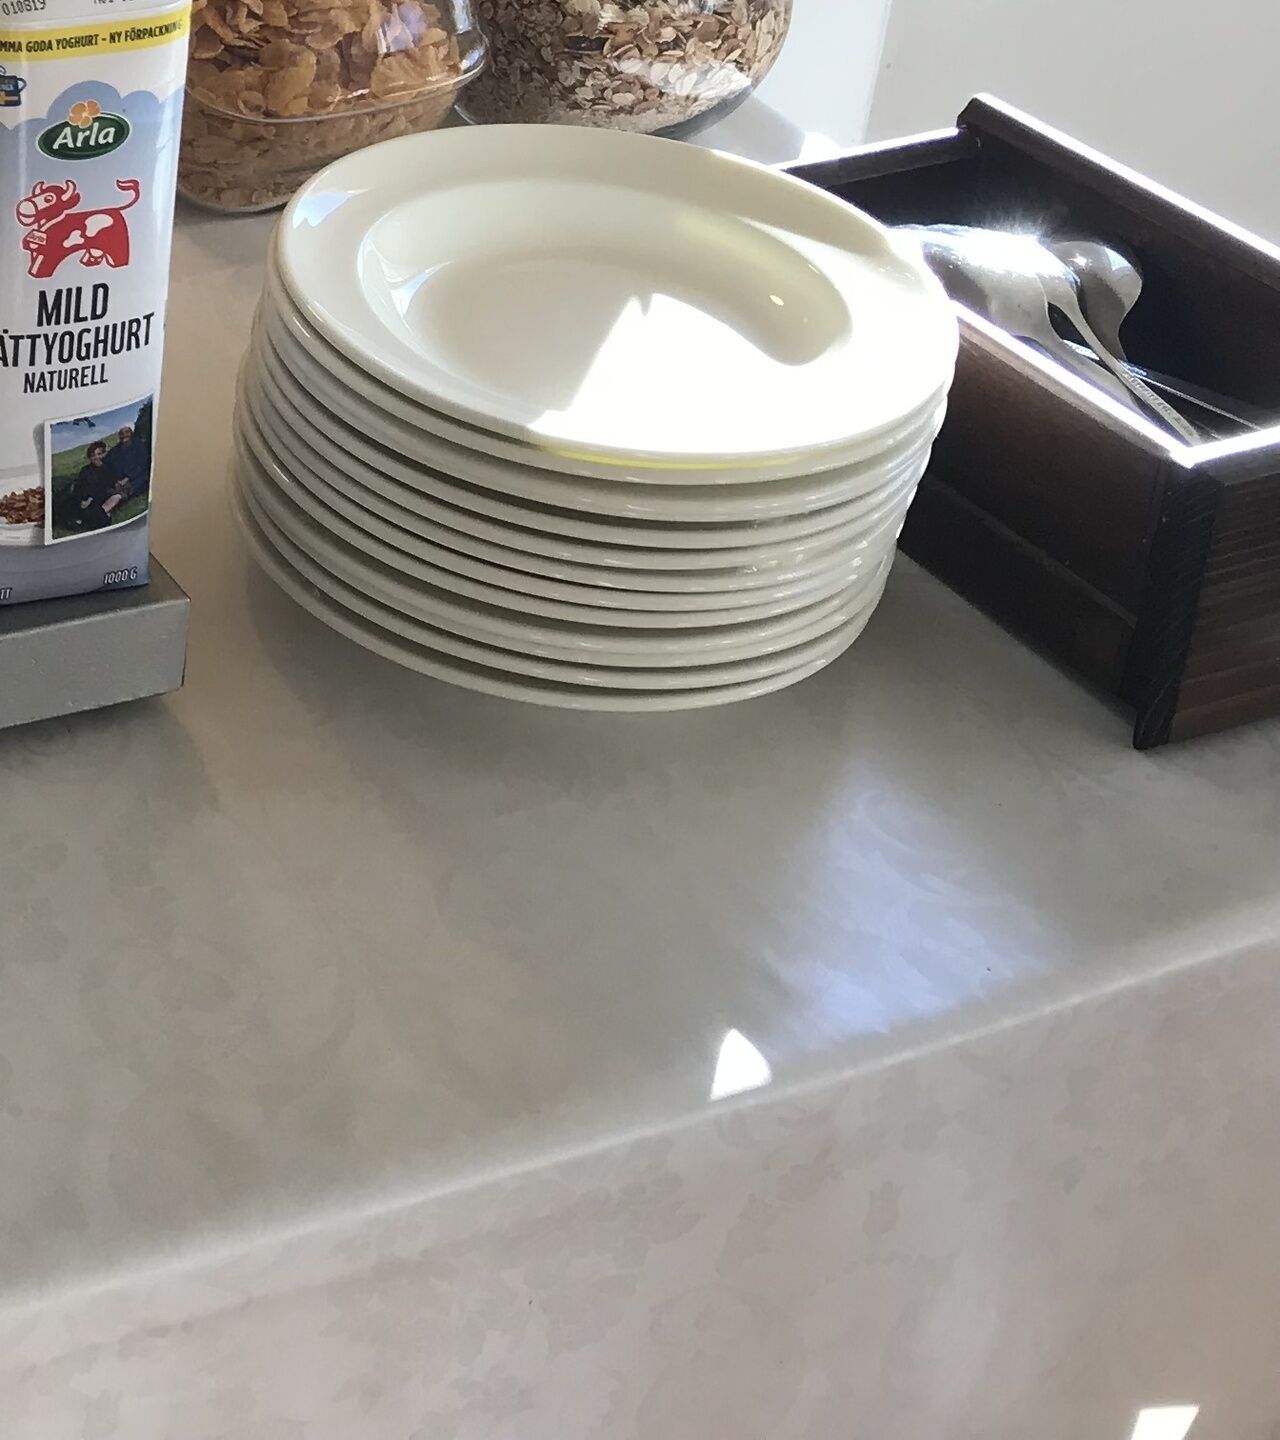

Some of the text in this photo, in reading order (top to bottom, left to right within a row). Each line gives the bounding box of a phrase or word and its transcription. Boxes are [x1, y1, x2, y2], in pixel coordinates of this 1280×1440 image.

[25, 39, 53, 52] GODA
[55, 33, 100, 50] YOGHURT
[109, 31, 123, 44] NY
[51, 120, 117, 151] Arla
[37, 282, 110, 327] MILD
[23, 363, 109, 394] NATURELL
[103, 568, 128, 585] 1000
